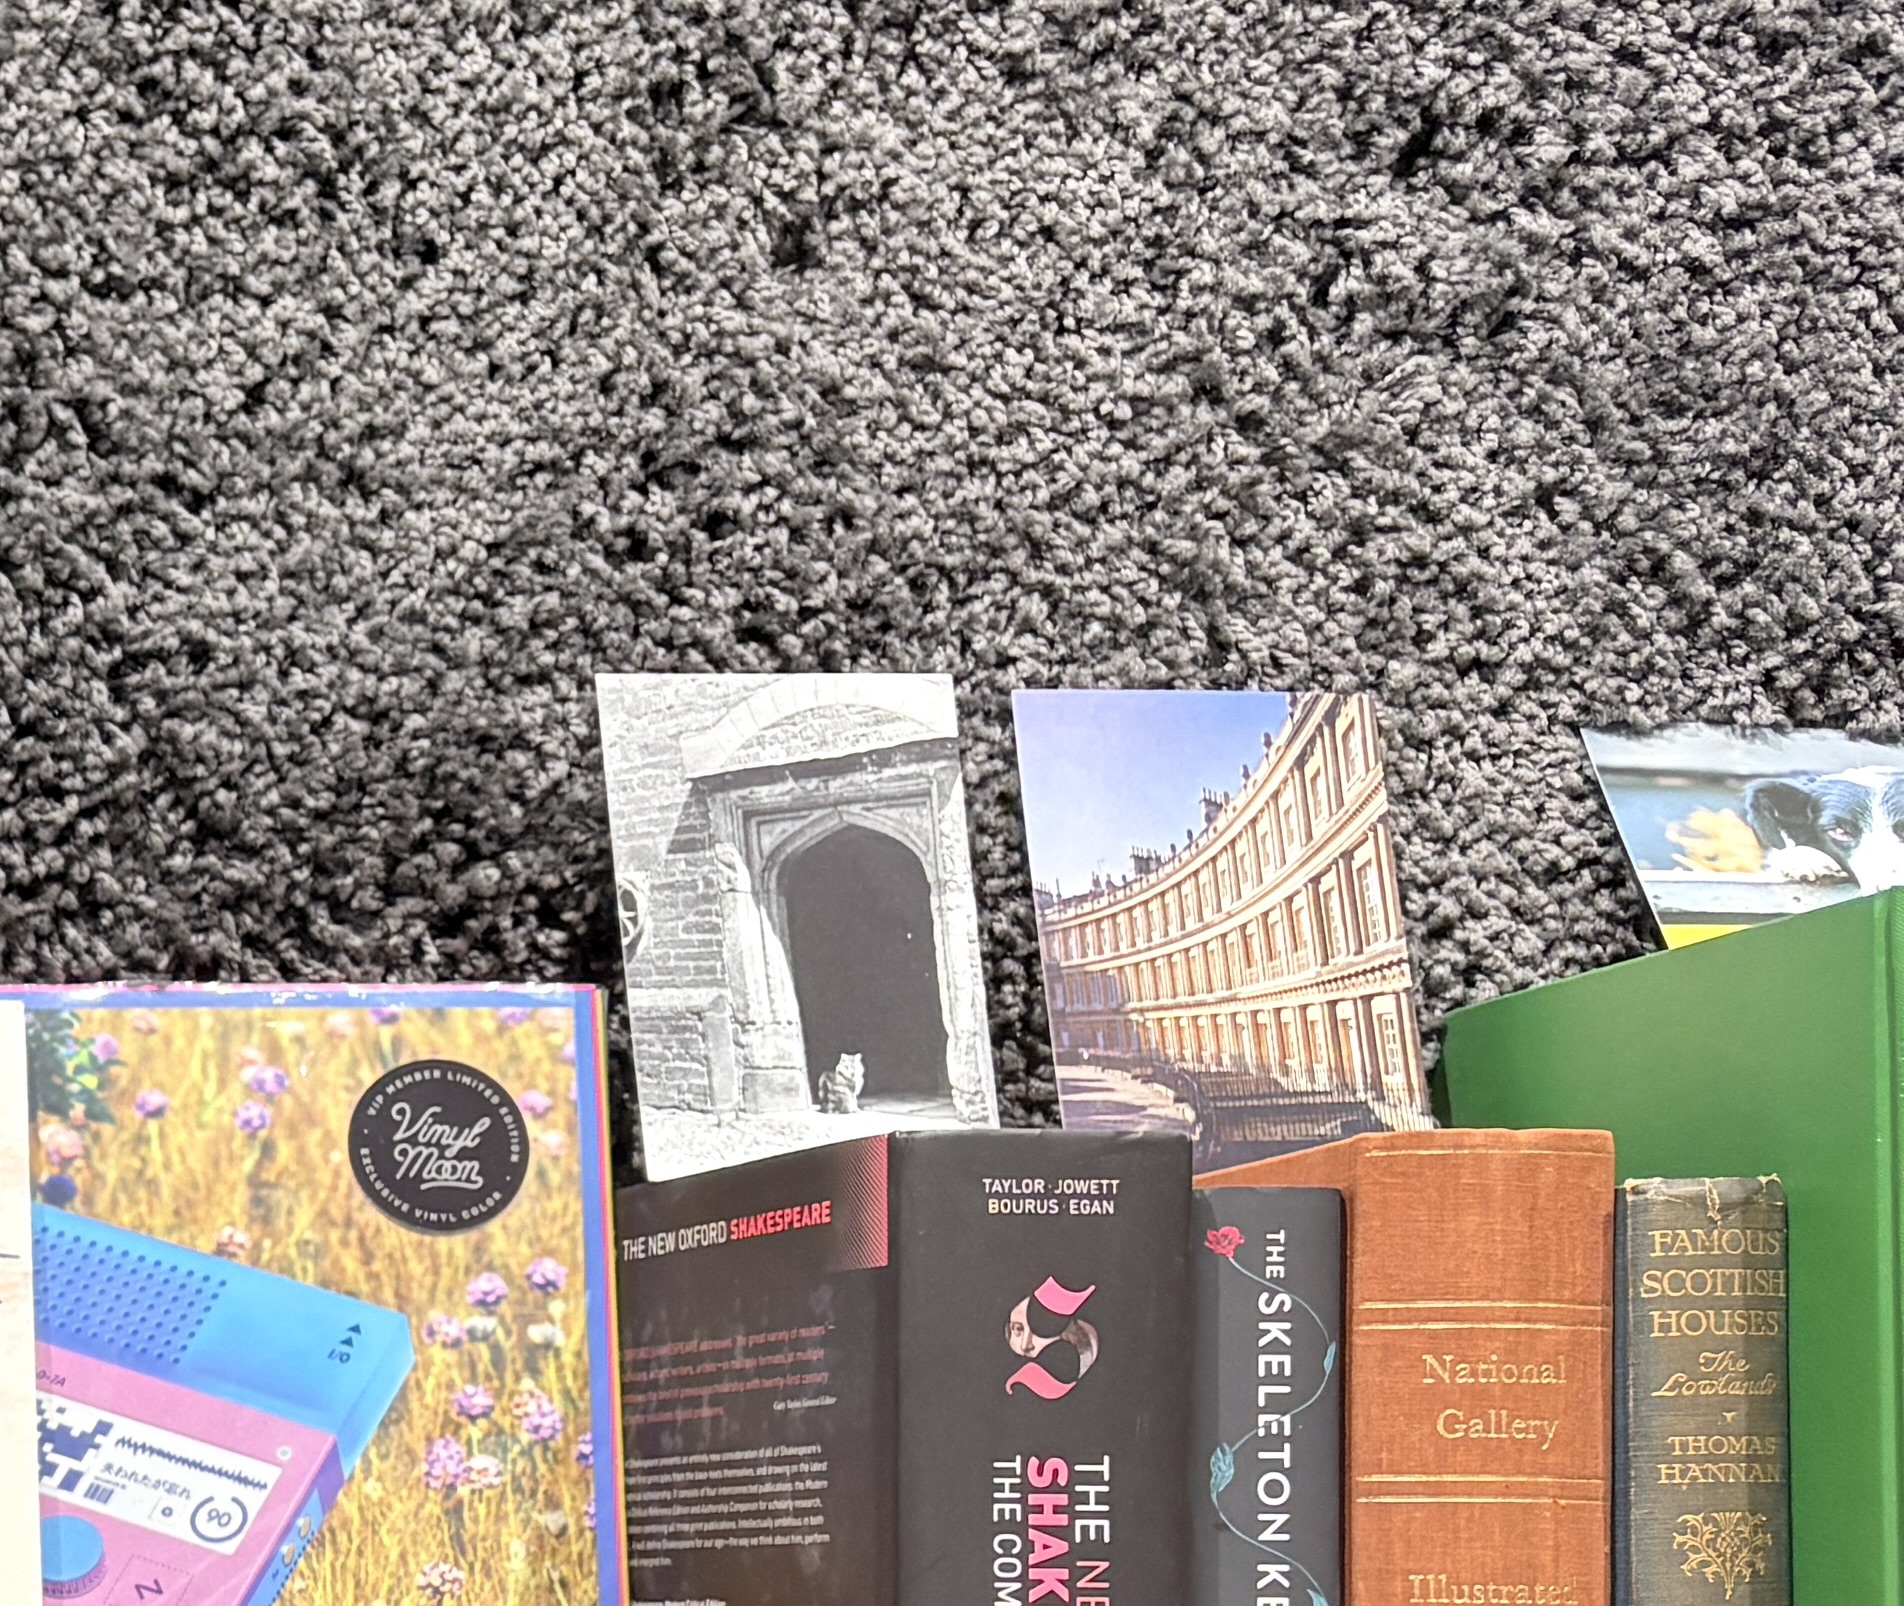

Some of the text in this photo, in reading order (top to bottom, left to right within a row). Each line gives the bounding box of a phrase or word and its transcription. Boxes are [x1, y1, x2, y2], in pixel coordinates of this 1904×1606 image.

[447, 1071, 500, 1105] LIMITED
[391, 1101, 492, 1158] Vinyl
[393, 1143, 484, 1190] Moon
[982, 1178, 1120, 1195] TAYLOR JOWETT
[415, 1207, 457, 1222] VINYL
[461, 1191, 502, 1219] COLOR
[988, 1199, 1115, 1215] BOURUS EGAN
[623, 1200, 832, 1262] THE NEW OXFORD SHAKESPEARE
[1648, 1228, 1782, 1258] FAMOUS
[1265, 1228, 1286, 1280] THE
[1641, 1268, 1787, 1299] SCOTTISH
[1649, 1309, 1780, 1338] HOUSES
[1422, 1354, 1568, 1384] National
[1699, 1351, 1751, 1373] The
[1256, 1291, 1293, 1542] SKELETON
[1436, 1409, 1560, 1451] Gallery
[1667, 1435, 1778, 1457] THOMAS
[993, 1454, 1022, 1523] THE
[1656, 1463, 1782, 1486] HANNAN
[1074, 1454, 1111, 1544] THE
[206, 1509, 232, 1528] 90
[1408, 1574, 1580, 1605] Illustrated
